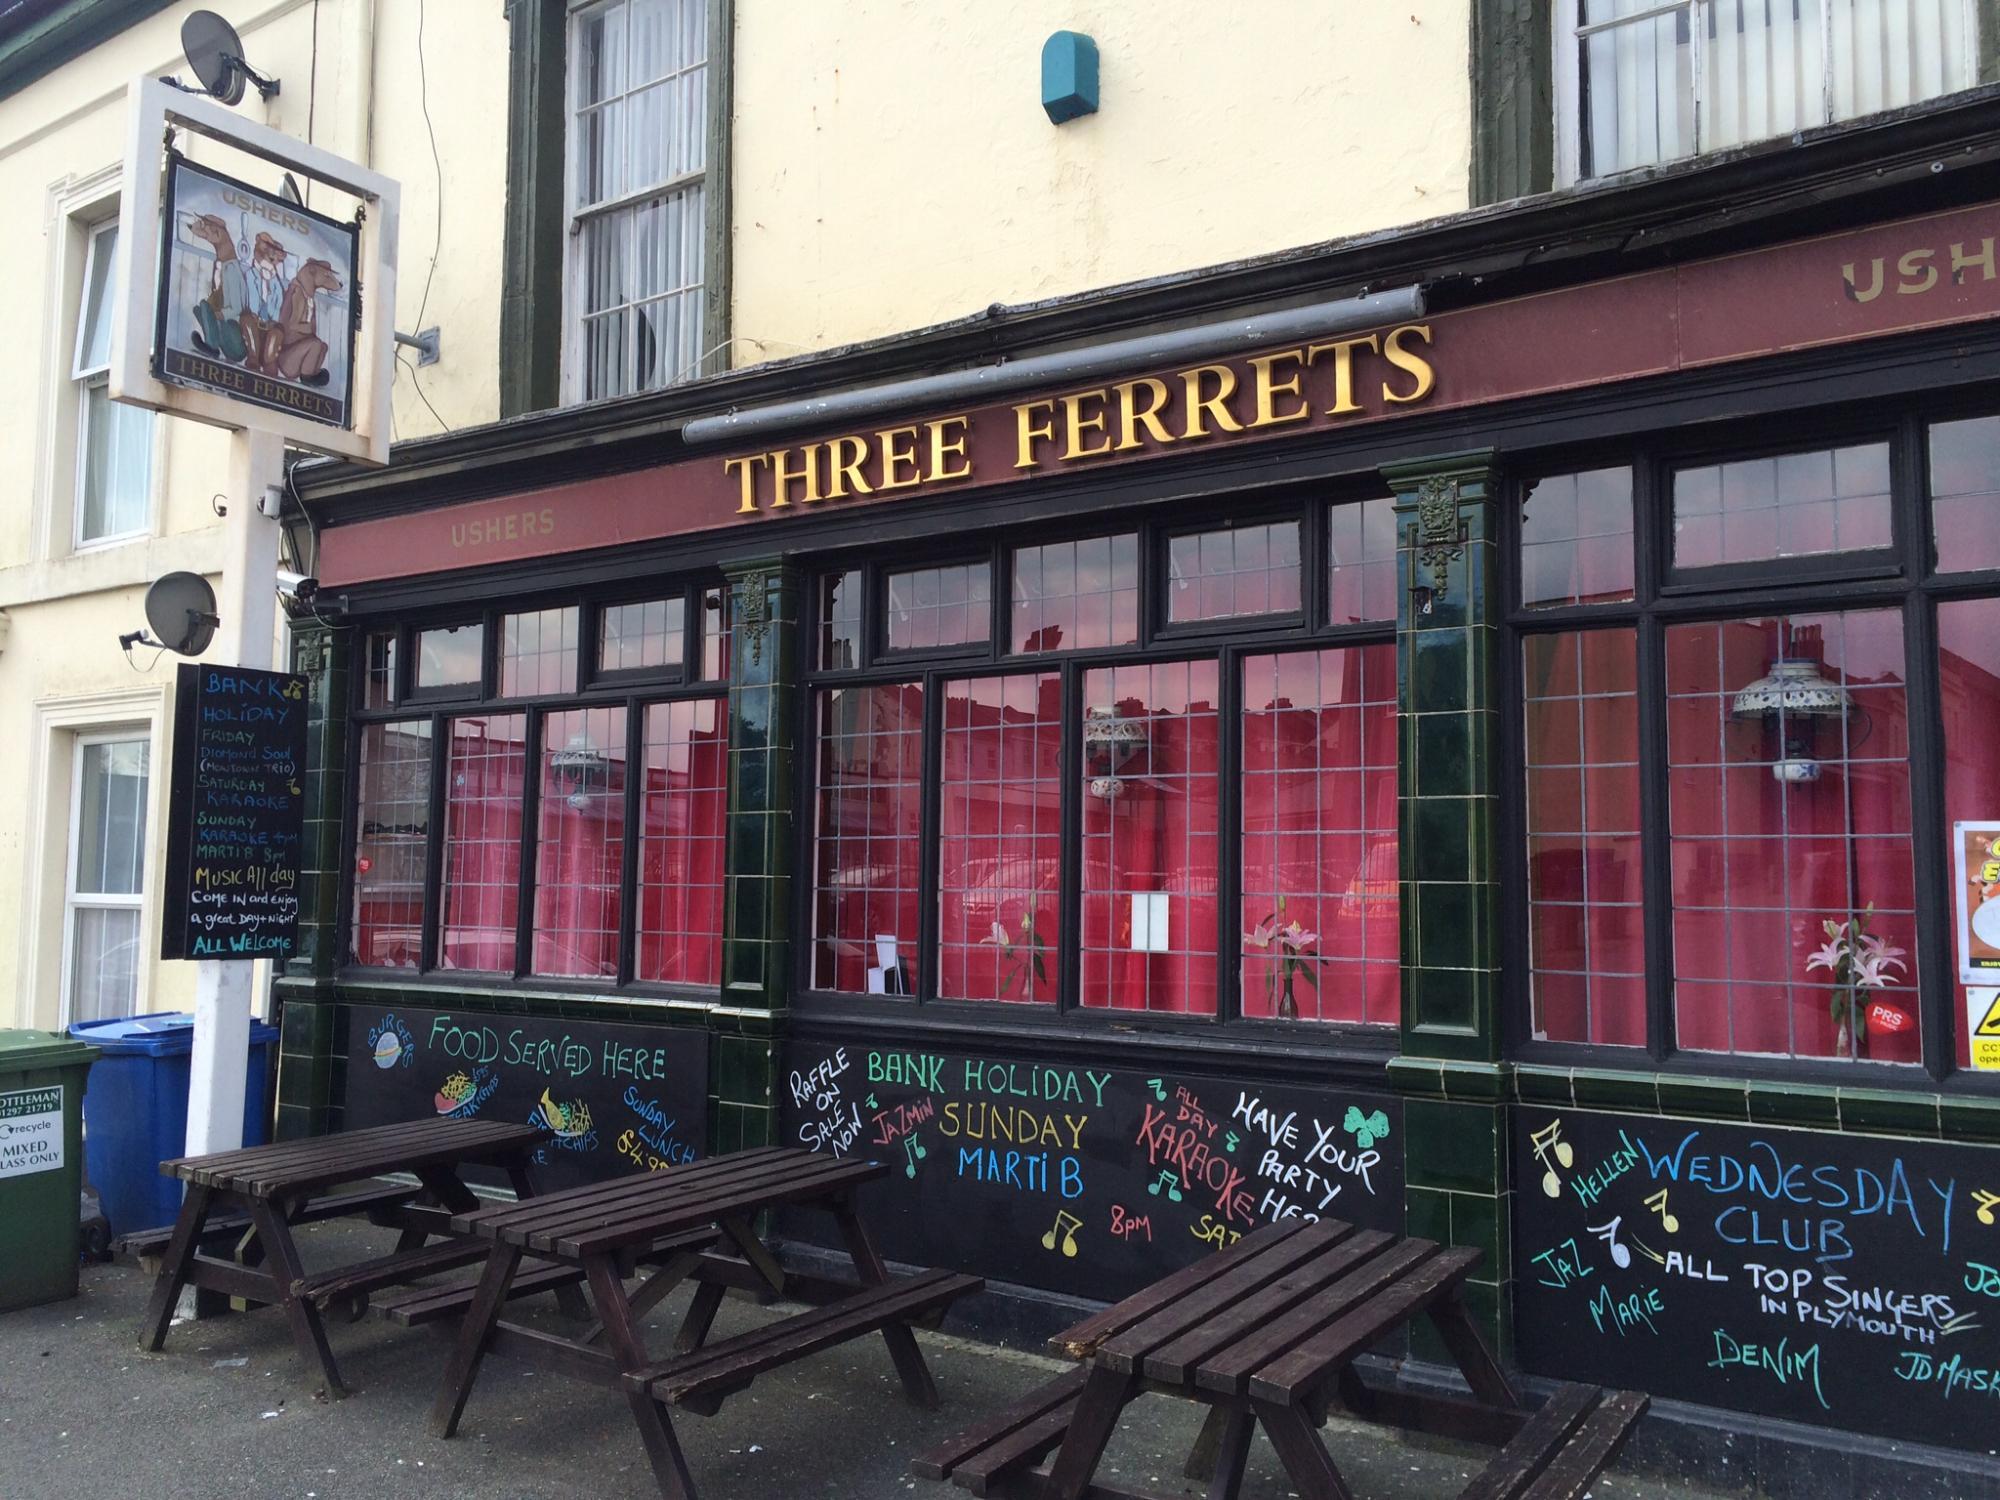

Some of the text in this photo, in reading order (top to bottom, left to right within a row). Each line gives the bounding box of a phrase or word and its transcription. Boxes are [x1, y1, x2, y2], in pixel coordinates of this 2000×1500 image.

[222, 190, 310, 236] USHERS
[177, 354, 334, 416] THREE FERRETS
[724, 325, 1436, 516] THREE FERRETS
[451, 509, 554, 548] USHERS
[205, 672, 289, 703] BANK
[203, 728, 255, 746] FRIDAY
[197, 774, 264, 793] SATURDAY
[207, 790, 288, 810] KARAOKE
[197, 811, 256, 830] SUNDAY
[200, 828, 268, 845] KARAOKE
[191, 890, 228, 908] COME
[233, 892, 246, 906] IN
[249, 891, 268, 904] and
[205, 913, 236, 931] great
[192, 932, 292, 956] ALL WELCOME
[1872, 1005, 1903, 1026] PRS
[368, 1013, 415, 1068] BURGERS
[428, 1016, 666, 1080] FOOD SERVED HERE
[789, 1046, 850, 1109] RAFFLE
[867, 1051, 945, 1093] BANK
[0, 1102, 53, 1117] 1297 21719
[623, 1085, 676, 1138] SUNDAY
[816, 1082, 841, 1111] ON
[1175, 1085, 1205, 1114] ALL
[15, 1120, 52, 1134] recycle
[799, 1099, 845, 1152] SALE
[832, 1101, 863, 1159] NOW
[939, 1102, 1088, 1149] SUNDAY
[1176, 1107, 1219, 1139] DAY
[1232, 1091, 1381, 1196] HAVE YOUR
[3, 1140, 48, 1158] MIXED
[29, 1151, 60, 1165] ONLY
[638, 1125, 696, 1167] LUNCH
[1136, 1103, 1257, 1227] KARAOKE
[1060, 1156, 1085, 1198] B
[1257, 1149, 1342, 1210] PARTY
[1570, 1129, 1640, 1208] HELLEN
[1637, 1131, 1956, 1256] WEDNESDAY
[1714, 1206, 1854, 1263] CLUB
[1530, 1237, 1595, 1289] JAZ
[1665, 1250, 1956, 1329] ALL TOP SINGERS
[1760, 1296, 1936, 1344] IN PLYMOUTH
